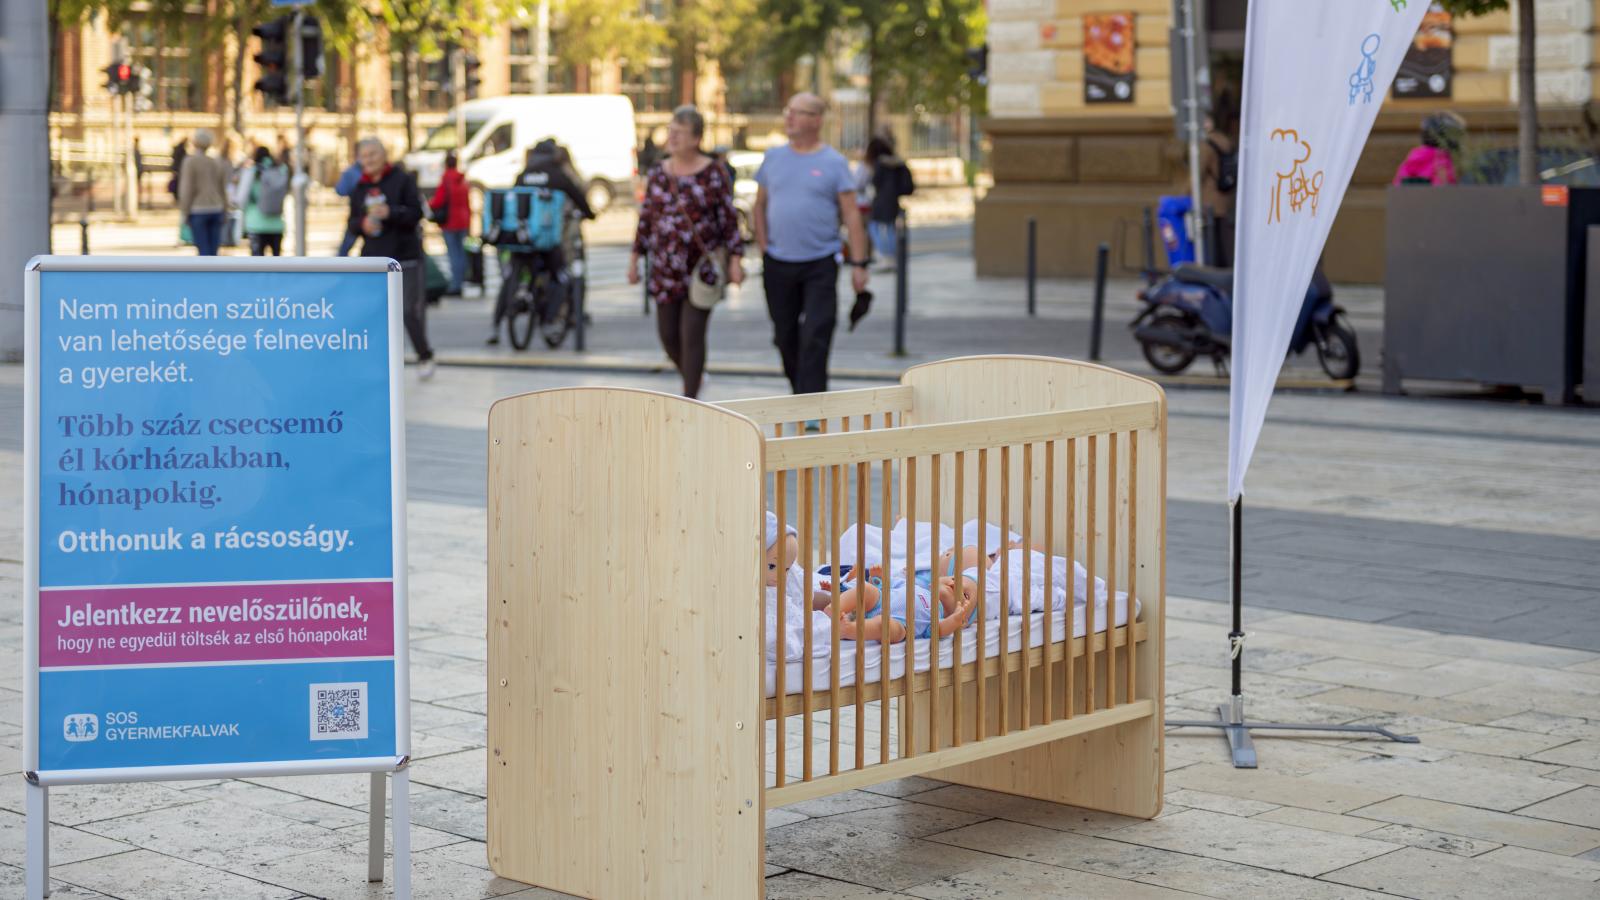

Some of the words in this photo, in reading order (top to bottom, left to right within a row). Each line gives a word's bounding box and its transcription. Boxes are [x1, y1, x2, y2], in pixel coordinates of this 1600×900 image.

[59, 298, 118, 320] Nem
[126, 297, 218, 320] minden
[226, 297, 334, 319] szülőnek
[58, 335, 102, 352] van
[111, 328, 247, 356] lehetősége
[254, 328, 368, 350] felnevelni
[59, 367, 73, 384] a
[81, 360, 194, 389] gyerekét.
[58, 414, 134, 438] Több
[141, 412, 201, 436] száz
[208, 409, 344, 435] csecsemő
[58, 447, 84, 472] él
[93, 445, 290, 471] kórházakban,
[58, 480, 222, 511] hónapokig.
[58, 527, 183, 553] Otthonuk
[190, 532, 206, 549] a
[214, 524, 354, 553] rácsoságy.
[57, 601, 182, 628] Jelentkezz
[189, 595, 369, 624] nevelőszülőnek,
[57, 635, 94, 654] hogy
[97, 637, 116, 649] ne
[119, 632, 177, 652] egyedül
[180, 628, 230, 647] töltsék
[233, 633, 251, 645] az
[254, 628, 285, 644] első
[288, 626, 367, 645] hónapokat!
[105, 710, 138, 725] SOS
[105, 723, 240, 741] GYERMEKFALVAK
